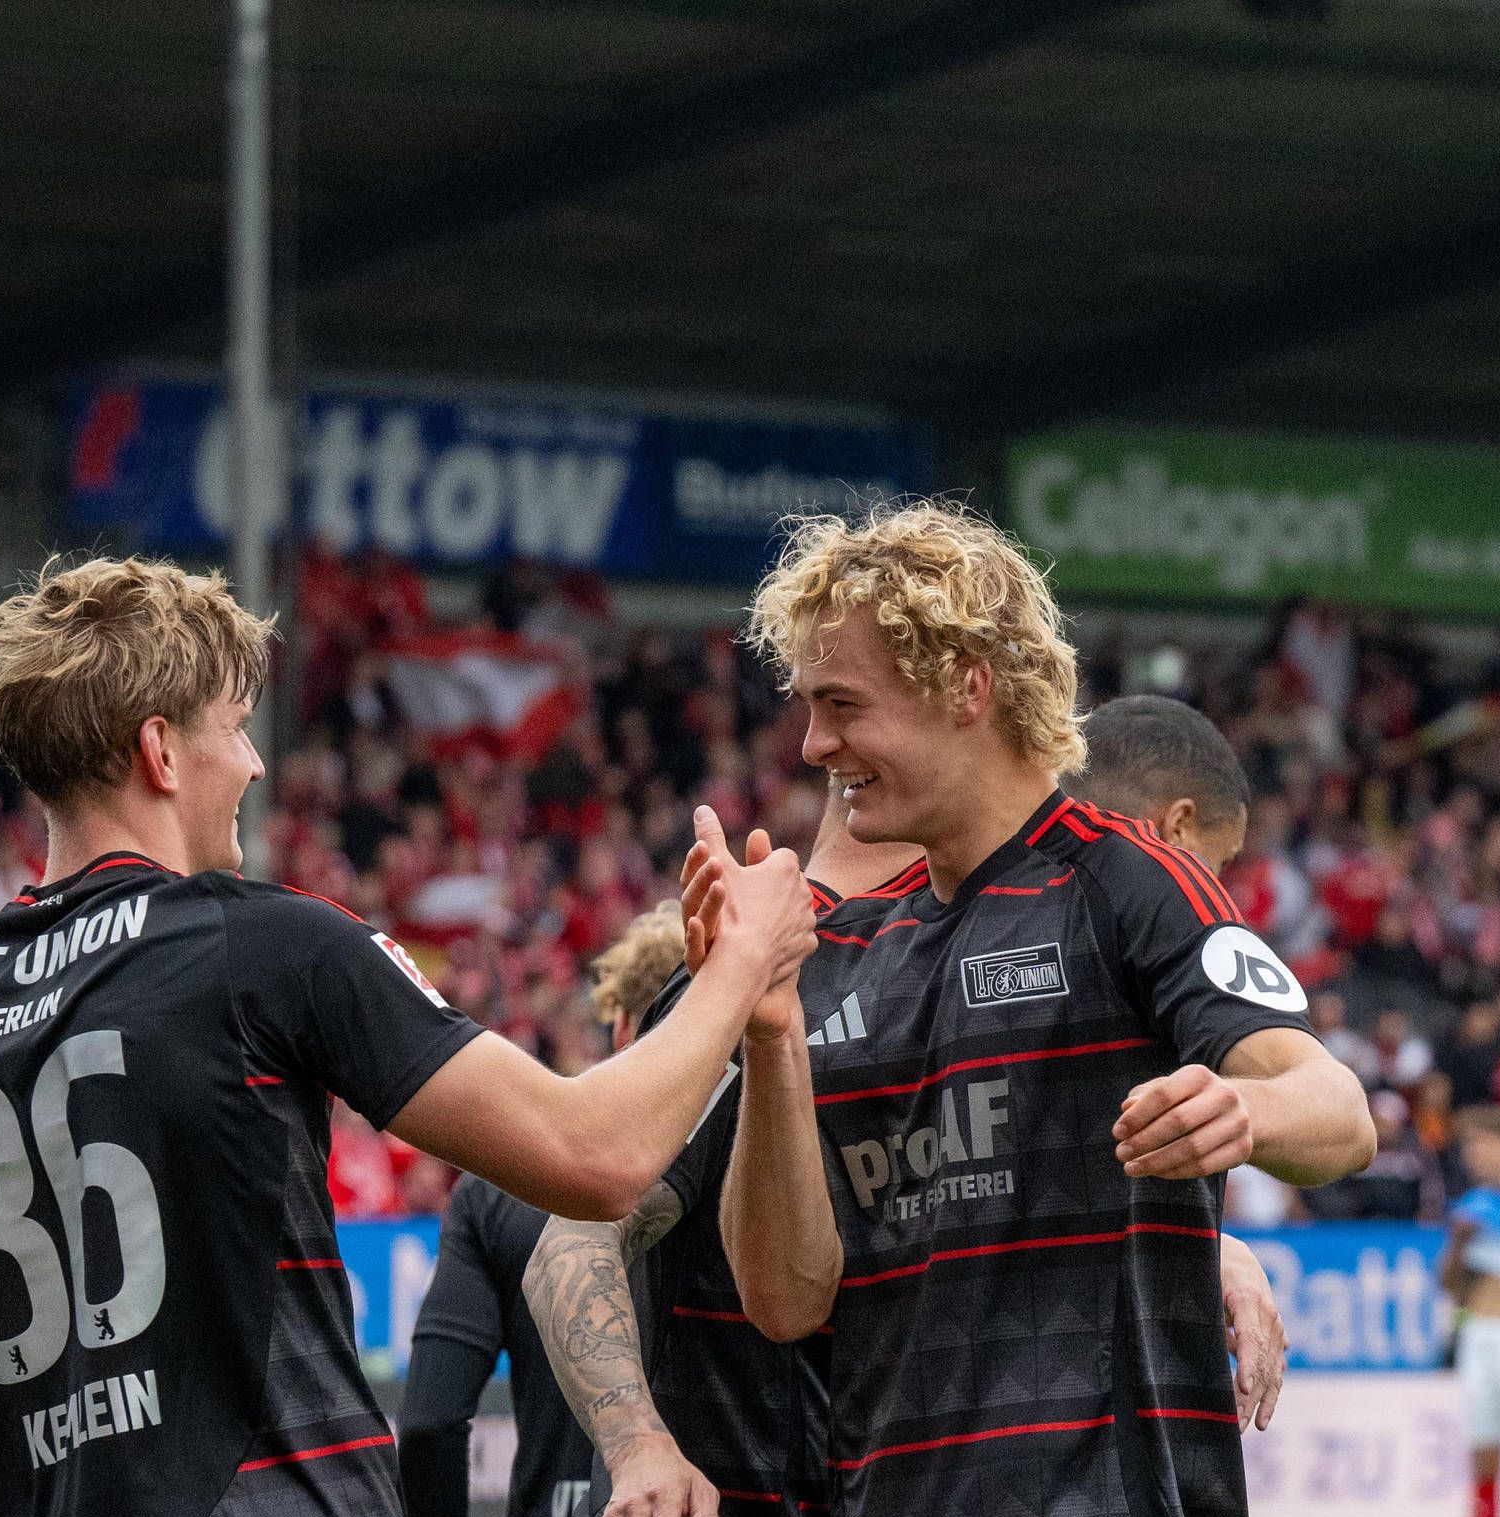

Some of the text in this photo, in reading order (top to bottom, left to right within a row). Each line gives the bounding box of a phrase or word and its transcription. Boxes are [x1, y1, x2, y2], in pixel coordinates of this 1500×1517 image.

[13, 894, 150, 985] UNION
[1019, 964, 1059, 990] UNION
[1225, 949, 1290, 995] JD
[925, 1169, 1015, 1215] FSTEREI
